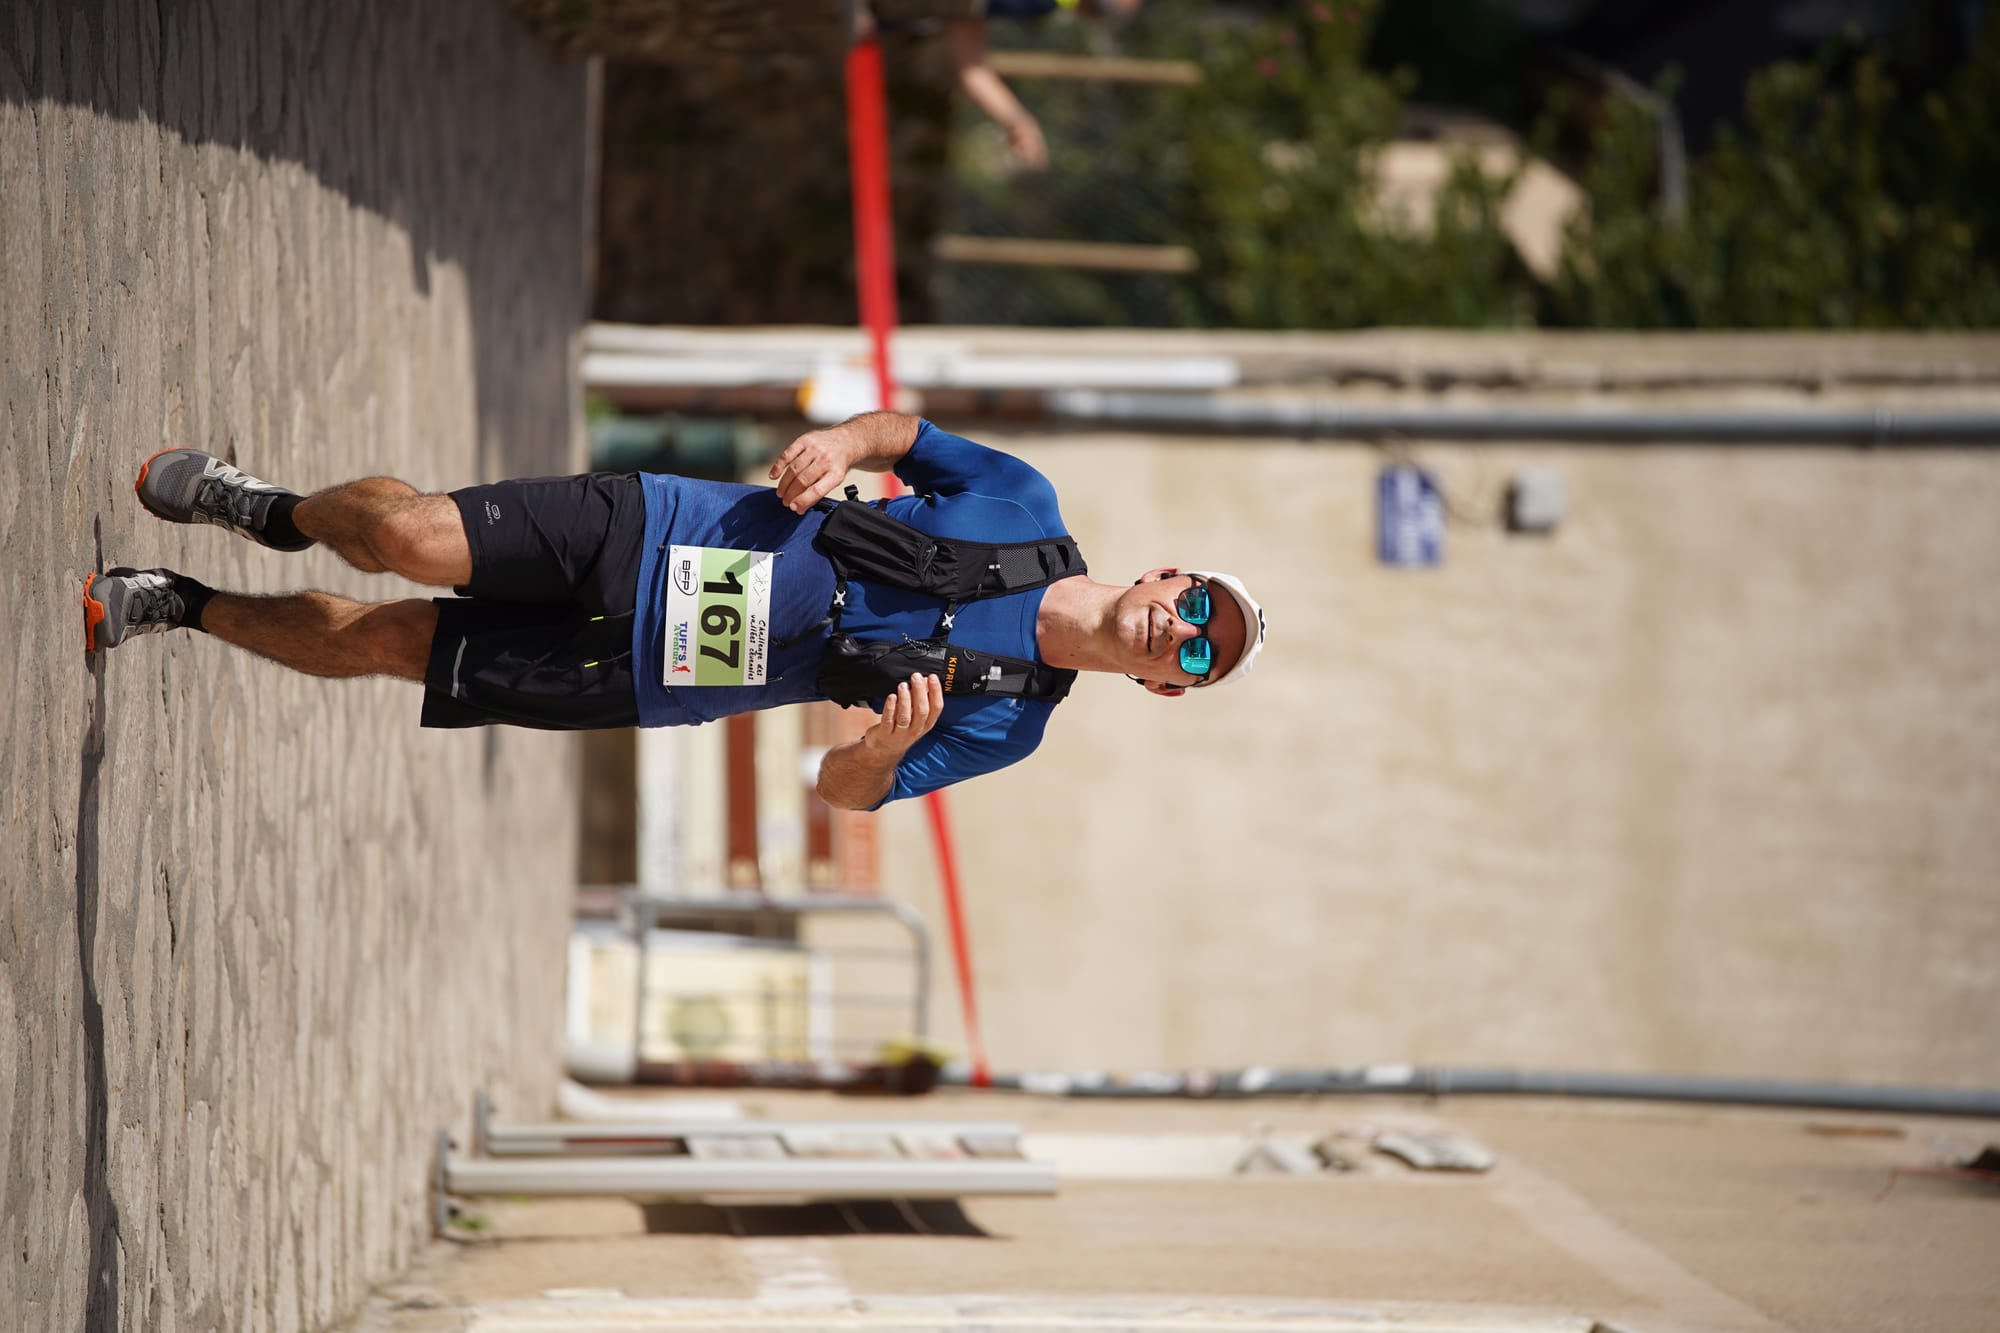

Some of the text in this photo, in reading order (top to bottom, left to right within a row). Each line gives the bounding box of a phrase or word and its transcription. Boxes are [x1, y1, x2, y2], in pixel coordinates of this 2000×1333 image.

[681, 560, 691, 590] BFP
[700, 571, 743, 669] 167
[749, 615, 758, 644] vallées
[678, 621, 688, 662] TUFF'S
[755, 620, 766, 676] Challenge des
[944, 657, 958, 692] KIPRUN
